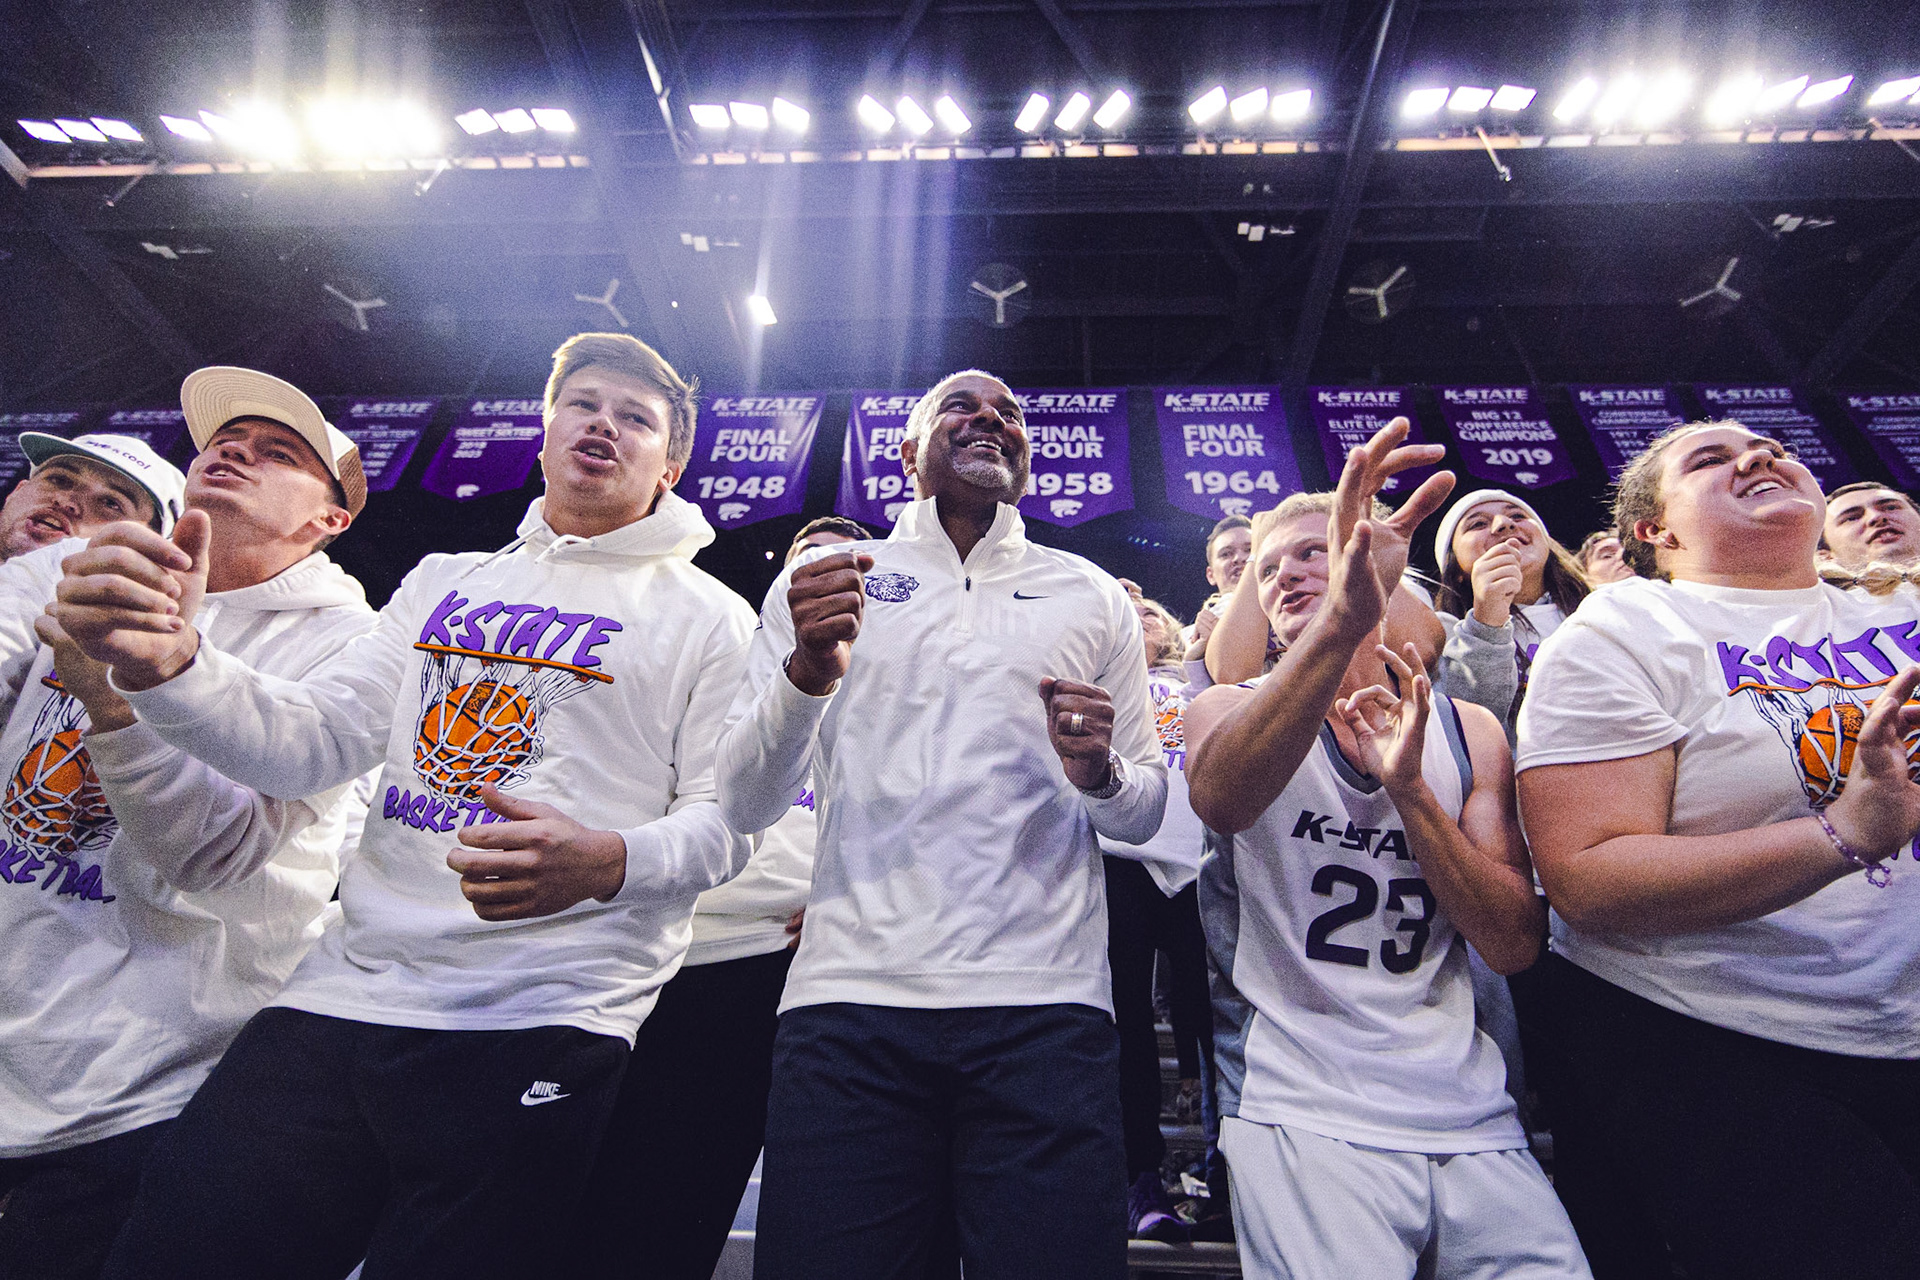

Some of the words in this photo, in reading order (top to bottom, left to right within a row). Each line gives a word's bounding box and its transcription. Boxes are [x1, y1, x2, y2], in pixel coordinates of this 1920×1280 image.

[1015, 394, 1117, 407] K-STATE
[1163, 393, 1270, 407] K-STATE
[1317, 391, 1401, 403] K-STATE
[1444, 389, 1529, 401] K-STATE
[1579, 389, 1665, 401] K-STATE
[1705, 388, 1794, 400] K-STATE
[711, 398, 817, 411] K-STATE
[861, 397, 921, 410] K-ST
[1471, 411, 1500, 421] BIG
[1501, 410, 1523, 421] 12
[1028, 425, 1105, 442] FINAL
[1183, 424, 1264, 441] FINAL
[1328, 420, 1364, 430] ELITE
[1456, 421, 1551, 431] CONFERENCE
[716, 428, 792, 446] FINAL
[870, 427, 909, 445] FIN
[1459, 430, 1557, 442] CHAMPIONS
[710, 445, 787, 462] FOUR
[1029, 442, 1104, 459] FOUR
[1185, 440, 1266, 457] FOUR
[1481, 448, 1554, 466] 2019
[122, 451, 152, 470] cool
[698, 475, 787, 499] 1948
[1027, 472, 1114, 496] 1958
[1184, 471, 1281, 495] 1964
[383, 785, 513, 834] BASKET
[1290, 809, 1418, 861] K-STA
[1305, 864, 1437, 976] 23
[529, 1080, 561, 1097] NIKE
